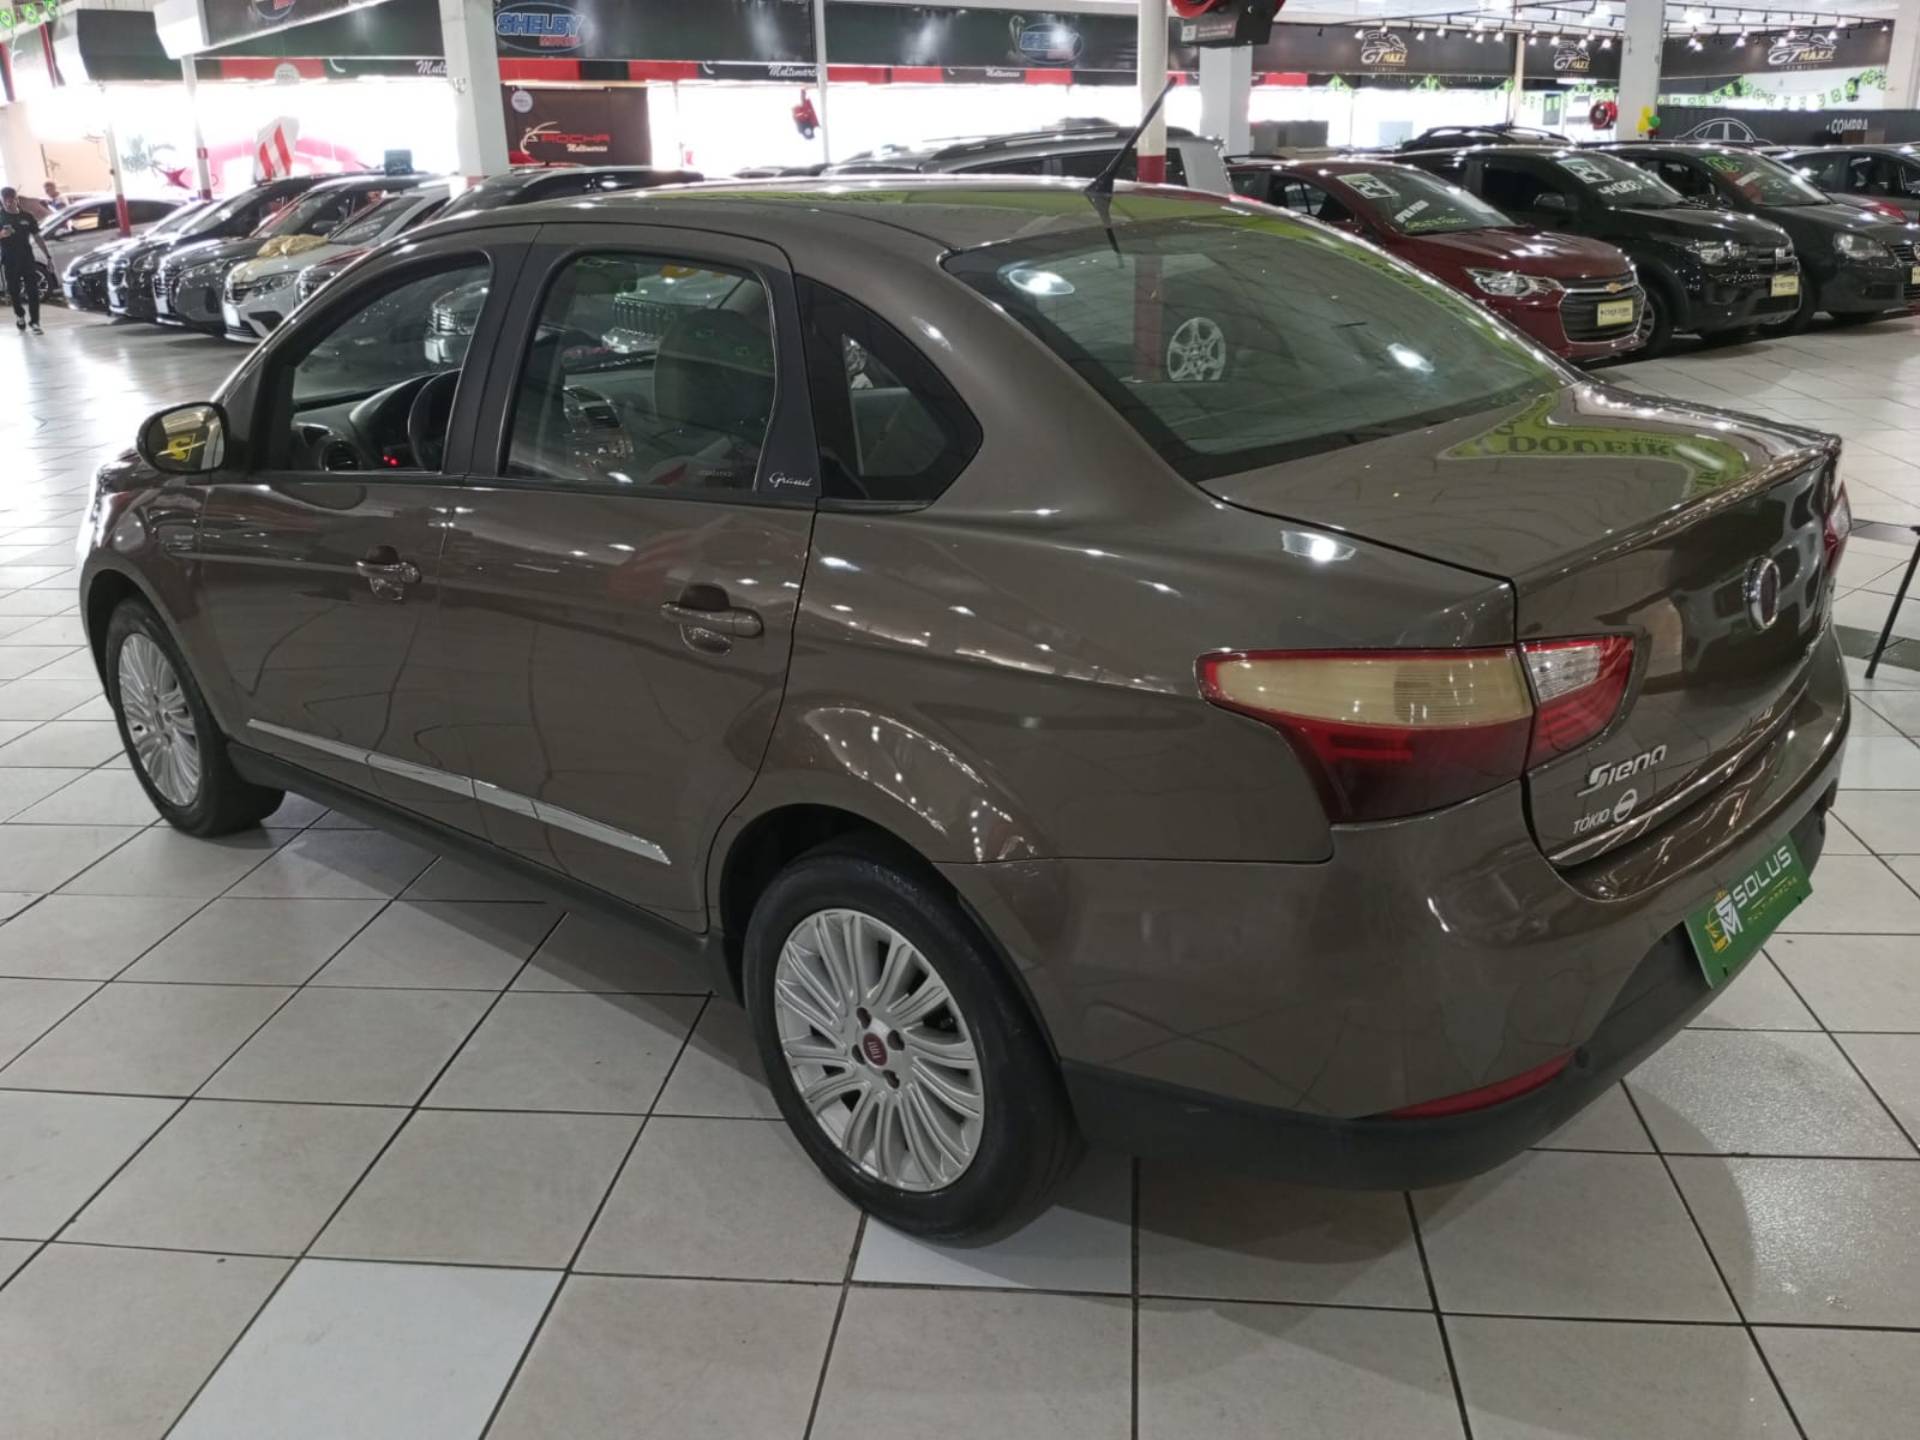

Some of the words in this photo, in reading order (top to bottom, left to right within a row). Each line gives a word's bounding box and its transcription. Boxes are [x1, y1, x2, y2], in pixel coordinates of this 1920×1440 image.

[496, 12, 585, 36] SHELBY
[769, 472, 813, 488] Grand
[1577, 745, 1667, 797] Siena
[1732, 845, 1792, 909] SOLUS
